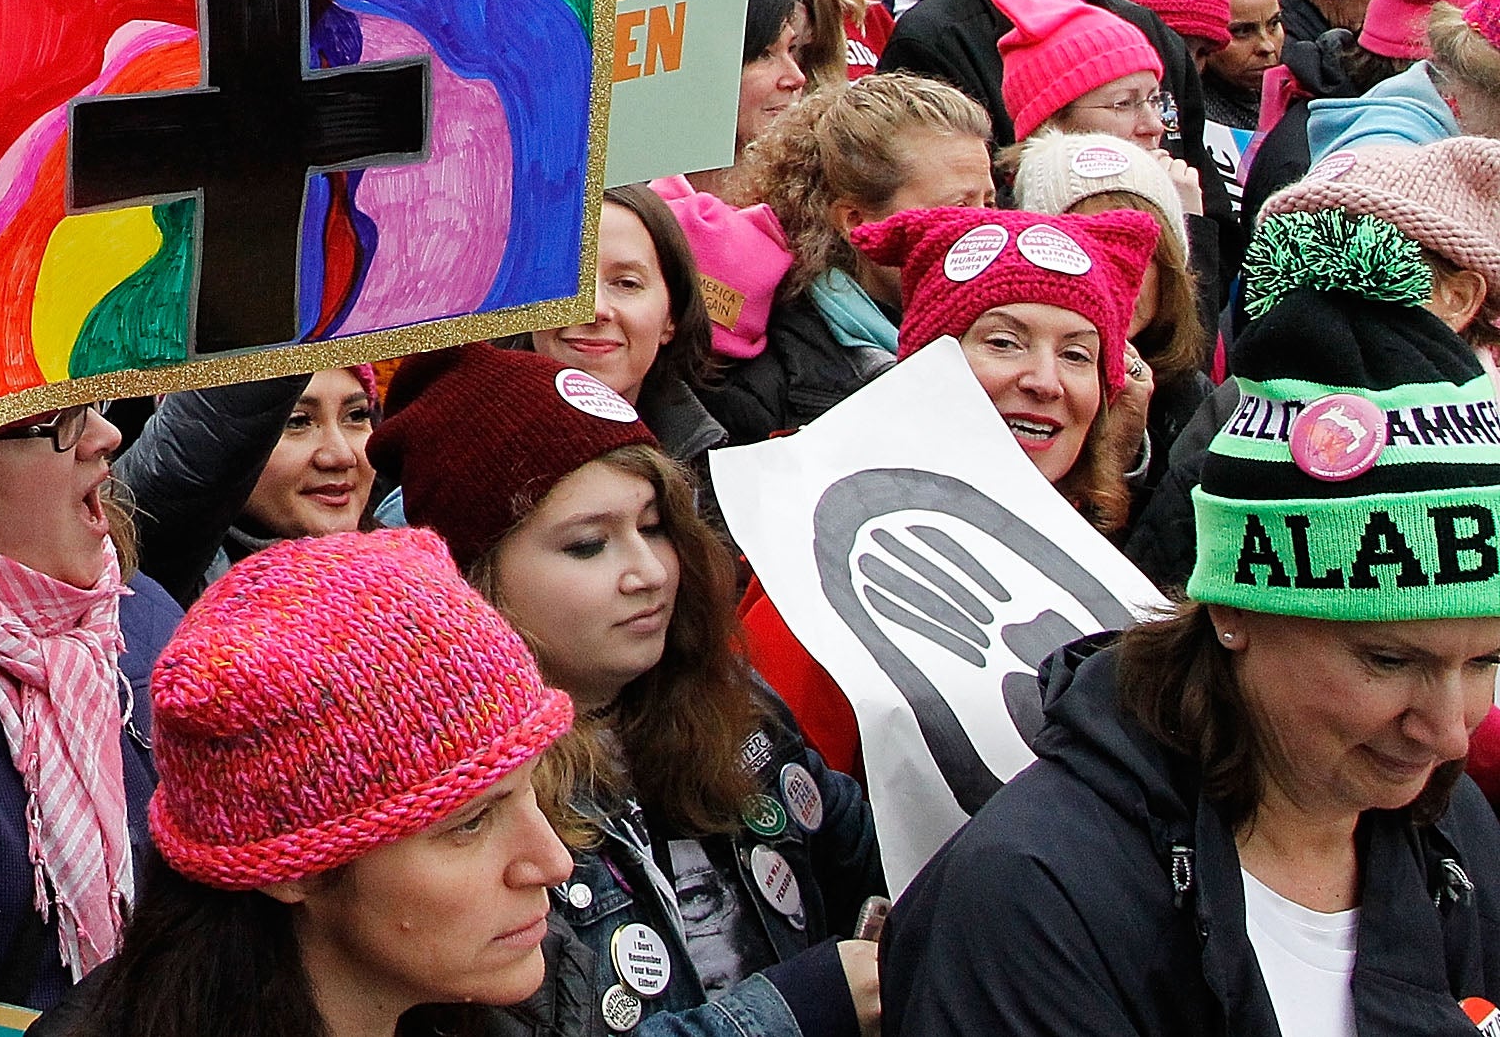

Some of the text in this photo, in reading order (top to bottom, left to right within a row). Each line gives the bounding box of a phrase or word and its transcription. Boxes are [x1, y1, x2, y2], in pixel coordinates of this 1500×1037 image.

[956, 241, 1002, 252] RIGHTS
[950, 254, 992, 266] HUMAN
[1030, 248, 1087, 264] HUMAN
[952, 264, 981, 272] RIGHTS
[1234, 503, 1500, 590] ALAB
[786, 772, 804, 800] FEEL
[794, 780, 813, 809] THE
[801, 794, 819, 824] BERN
[638, 942, 654, 953] Don't
[628, 952, 662, 965] Remember
[630, 965, 663, 977] Your Name
